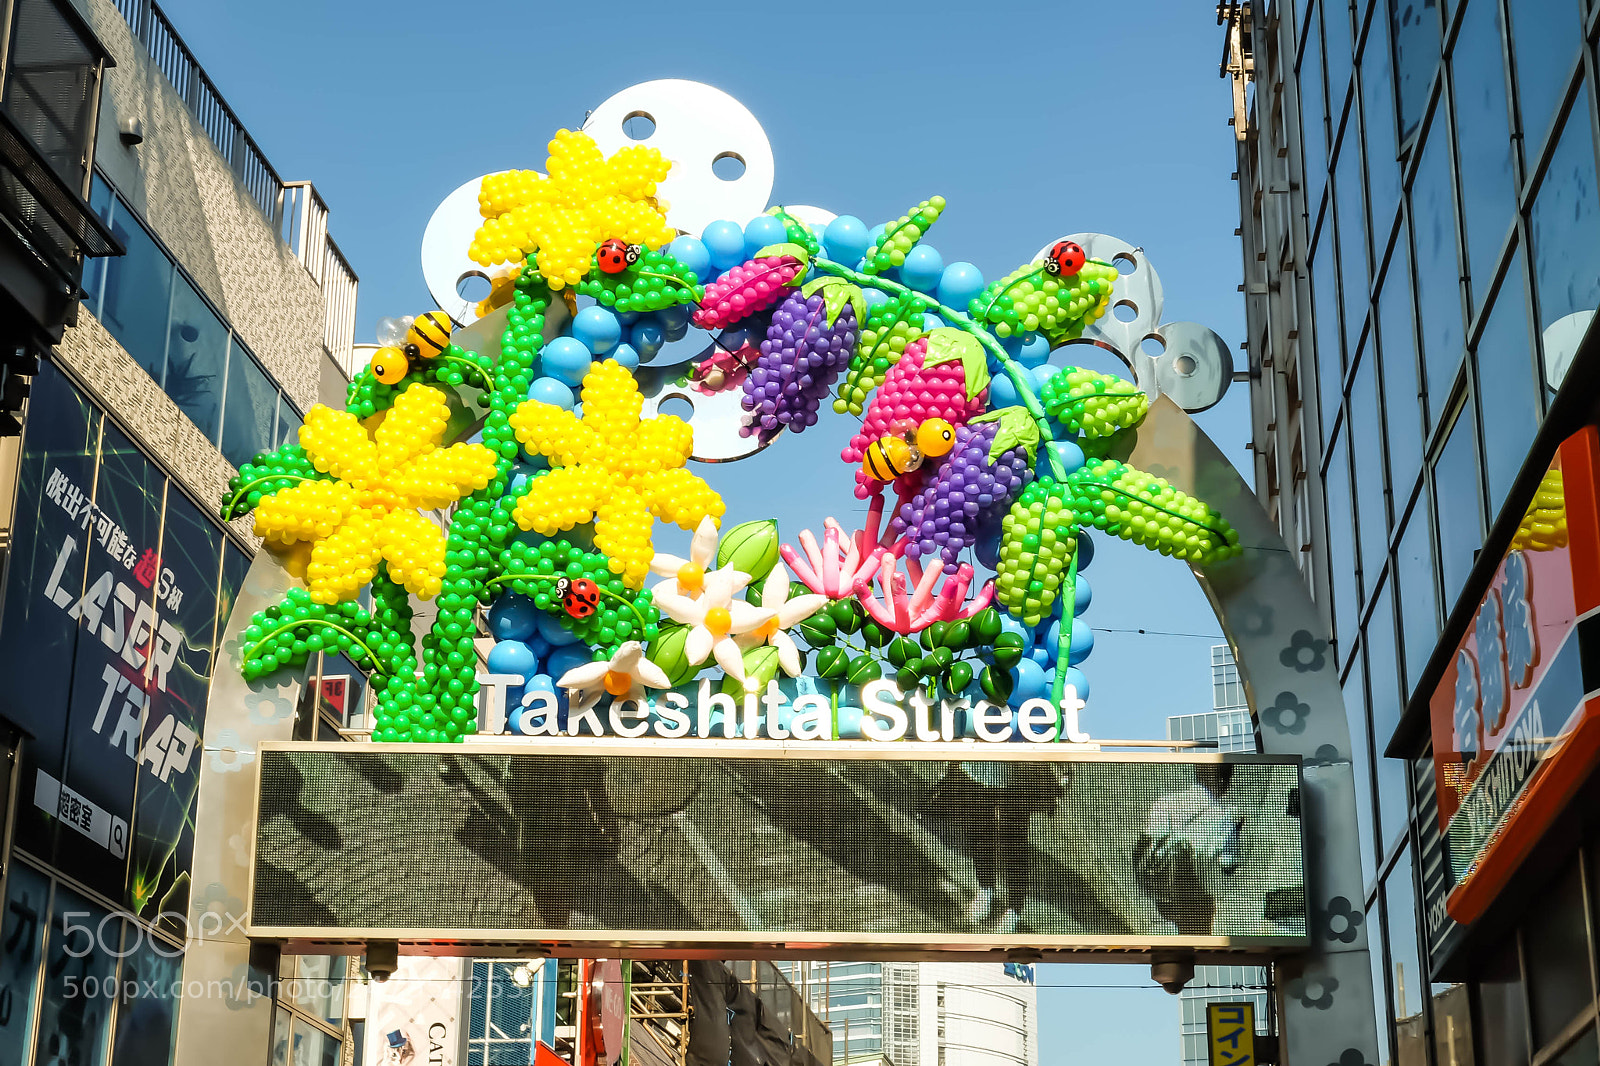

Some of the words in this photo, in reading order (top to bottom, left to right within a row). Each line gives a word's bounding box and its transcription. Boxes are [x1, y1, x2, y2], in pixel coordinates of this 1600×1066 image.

[44, 534, 182, 693] LASER
[92, 663, 198, 784] TRAP
[477, 673, 833, 741] Takeshita
[859, 678, 1091, 744] Street
